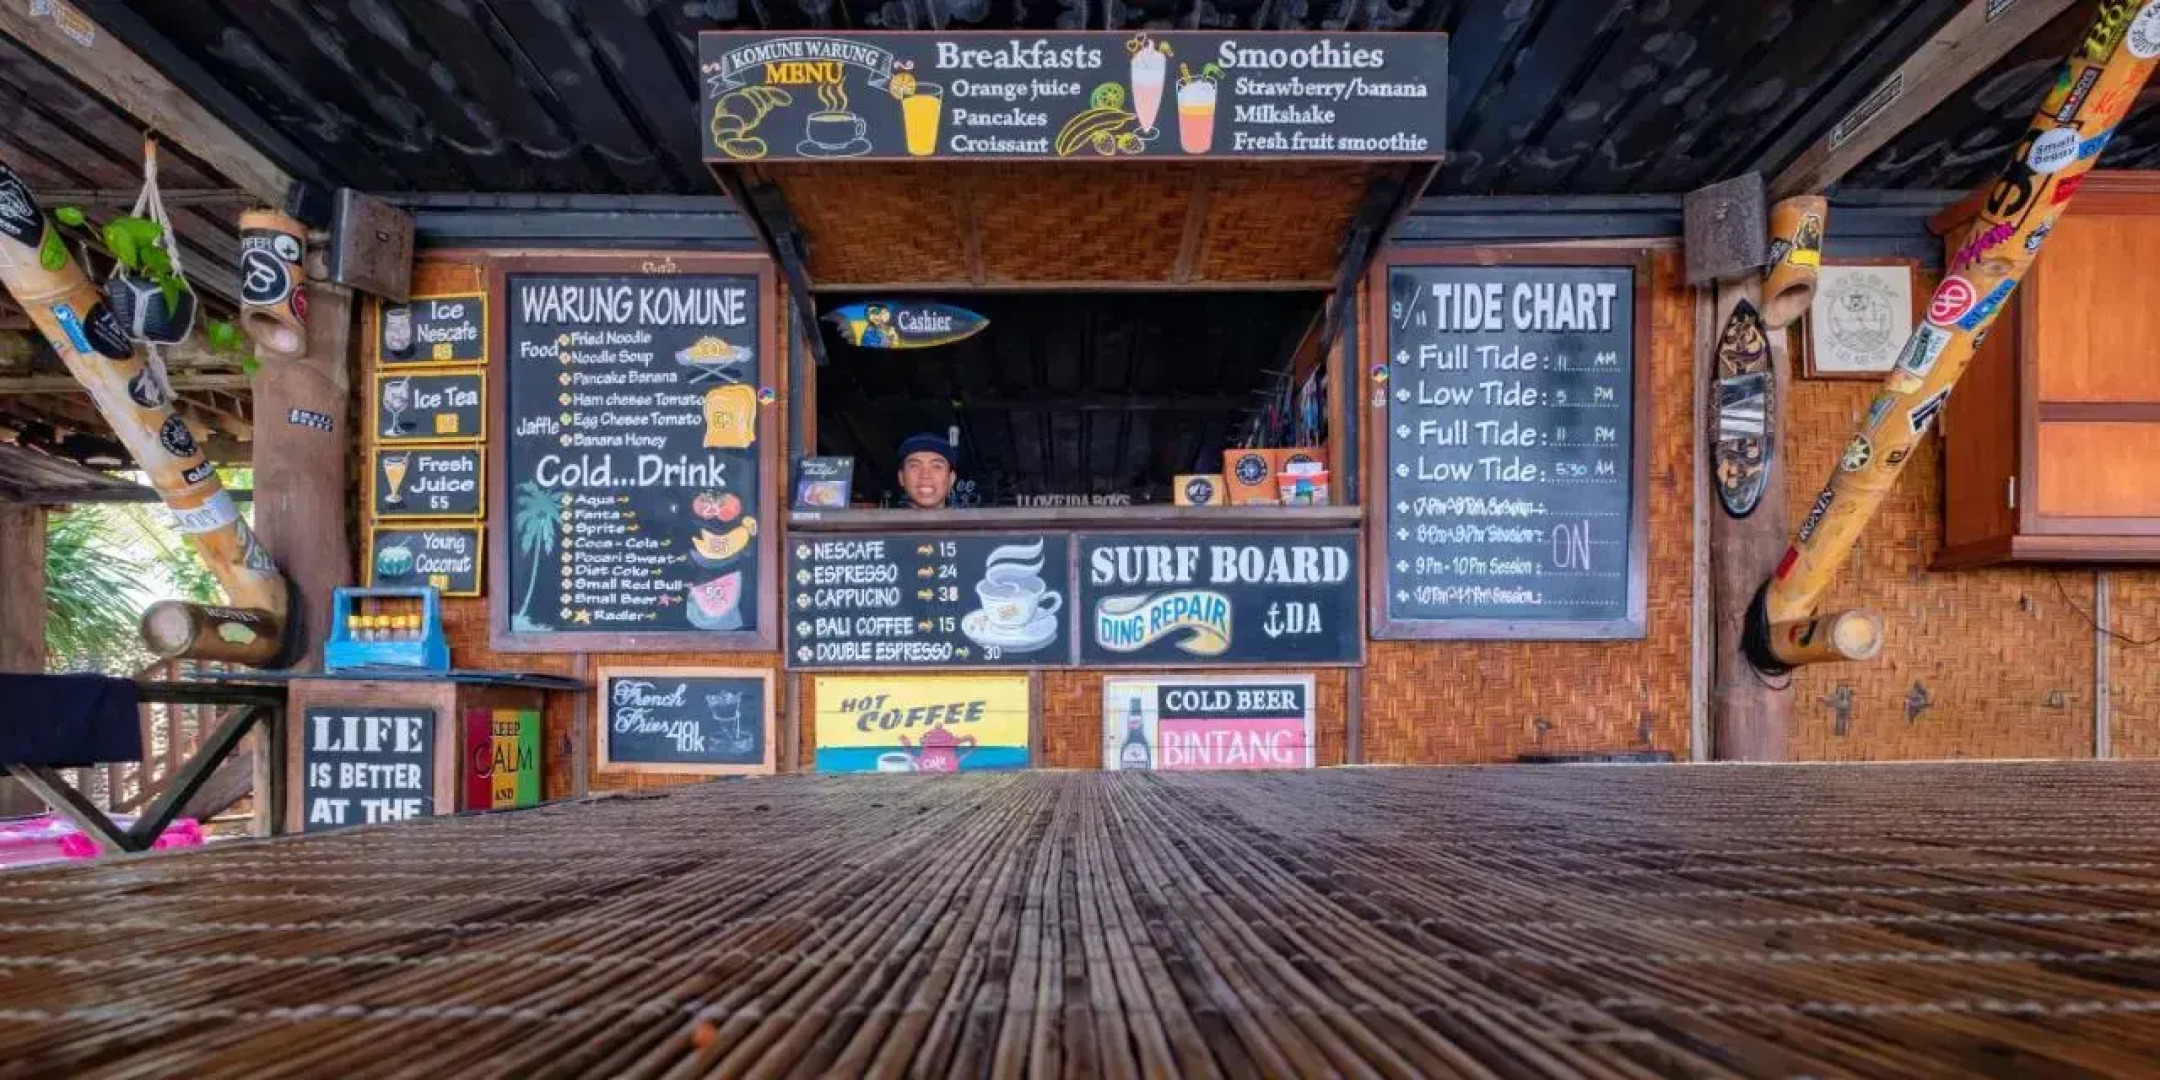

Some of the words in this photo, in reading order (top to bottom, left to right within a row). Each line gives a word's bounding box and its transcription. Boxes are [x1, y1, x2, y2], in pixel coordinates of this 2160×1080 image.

[731, 41, 804, 68] KOMUNE
[805, 41, 880, 67] WARUNG
[936, 41, 1102, 70] Breakfasts
[1217, 40, 1385, 69] Smoothies
[764, 61, 844, 84] MENU
[952, 79, 1029, 102] Orange
[1030, 79, 1081, 102] juice
[1234, 77, 1428, 101] Strawberry/banana
[952, 107, 1048, 126] Pancakes
[1234, 106, 1336, 124] Milkshake
[951, 134, 1048, 153] Croissant
[1233, 132, 1289, 151] Fresh
[1290, 132, 1337, 151] fruit
[1338, 132, 1428, 152] smoothie
[431, 300, 465, 320] Ice
[522, 286, 633, 324] WARUNG
[639, 287, 747, 326] KOMUNE
[1432, 283, 1504, 332] TIDE
[1512, 283, 1618, 332] CHART
[417, 321, 478, 342] Nescafe
[898, 311, 952, 332] Cashier
[570, 331, 604, 346] Fried
[606, 330, 653, 345] Noodle
[520, 340, 559, 358] Food
[572, 351, 617, 365] Noodle
[619, 350, 654, 367] Soup
[1420, 344, 1468, 370] Full
[1594, 351, 1617, 366] AM
[573, 372, 628, 386] Pancake
[629, 370, 678, 384] Banana
[414, 389, 442, 409] Ice
[444, 386, 478, 406] Tea
[573, 393, 603, 406] Ham
[655, 392, 705, 406] Tomato
[1418, 380, 1474, 406] Low
[516, 417, 560, 438] Jaffle
[573, 413, 599, 428] Egg
[651, 412, 702, 426] Tomato
[573, 433, 622, 447] Banana
[625, 434, 668, 450] Honey
[1420, 420, 1468, 446] Full
[1594, 427, 1616, 442] PM
[418, 456, 474, 472] Fresh
[1418, 456, 1473, 482] Low
[410, 476, 475, 493] Juice
[575, 494, 615, 507] Aqua
[575, 510, 620, 520] Fanta
[574, 522, 626, 536] Sprite
[423, 532, 466, 554] Young
[575, 537, 613, 549] Coca
[625, 537, 659, 549] Cola
[814, 541, 885, 560] NESCAFE
[939, 542, 957, 558] 15
[1552, 519, 1591, 571] ON
[415, 553, 472, 574] Coconut
[574, 553, 623, 564] Pocari
[626, 552, 674, 564] Sweat
[1091, 545, 1199, 585] SURF
[1209, 545, 1349, 584] BOARD
[574, 564, 609, 577] Diet
[612, 565, 650, 577] Coke
[814, 564, 898, 585] ESPRESSO
[938, 565, 958, 580] 24
[574, 578, 617, 591] Small
[621, 579, 650, 591] Red
[654, 579, 683, 591] Bull
[574, 593, 617, 604] Small
[620, 593, 657, 605] Beer
[815, 588, 900, 608] CAPPUCINO
[816, 617, 852, 637] BALI
[856, 616, 914, 636] COFFEE
[939, 617, 956, 632] 15
[1101, 614, 1145, 645] DING
[1150, 594, 1227, 636] REPAIR
[816, 642, 872, 662] DOUBLE
[875, 642, 953, 662] ESPRESSO
[613, 680, 688, 706] French
[841, 694, 891, 712] HOT
[1165, 689, 1232, 711] COLD
[1236, 689, 1299, 711] BEER
[615, 707, 669, 733] Fries
[856, 700, 987, 732] COFFEE
[312, 716, 423, 752] LIFE
[1163, 730, 1295, 765] BINTANG
[474, 742, 533, 776] CALM
[310, 763, 332, 788] IS
[340, 763, 422, 789] BETTER
[310, 798, 350, 824] AT
